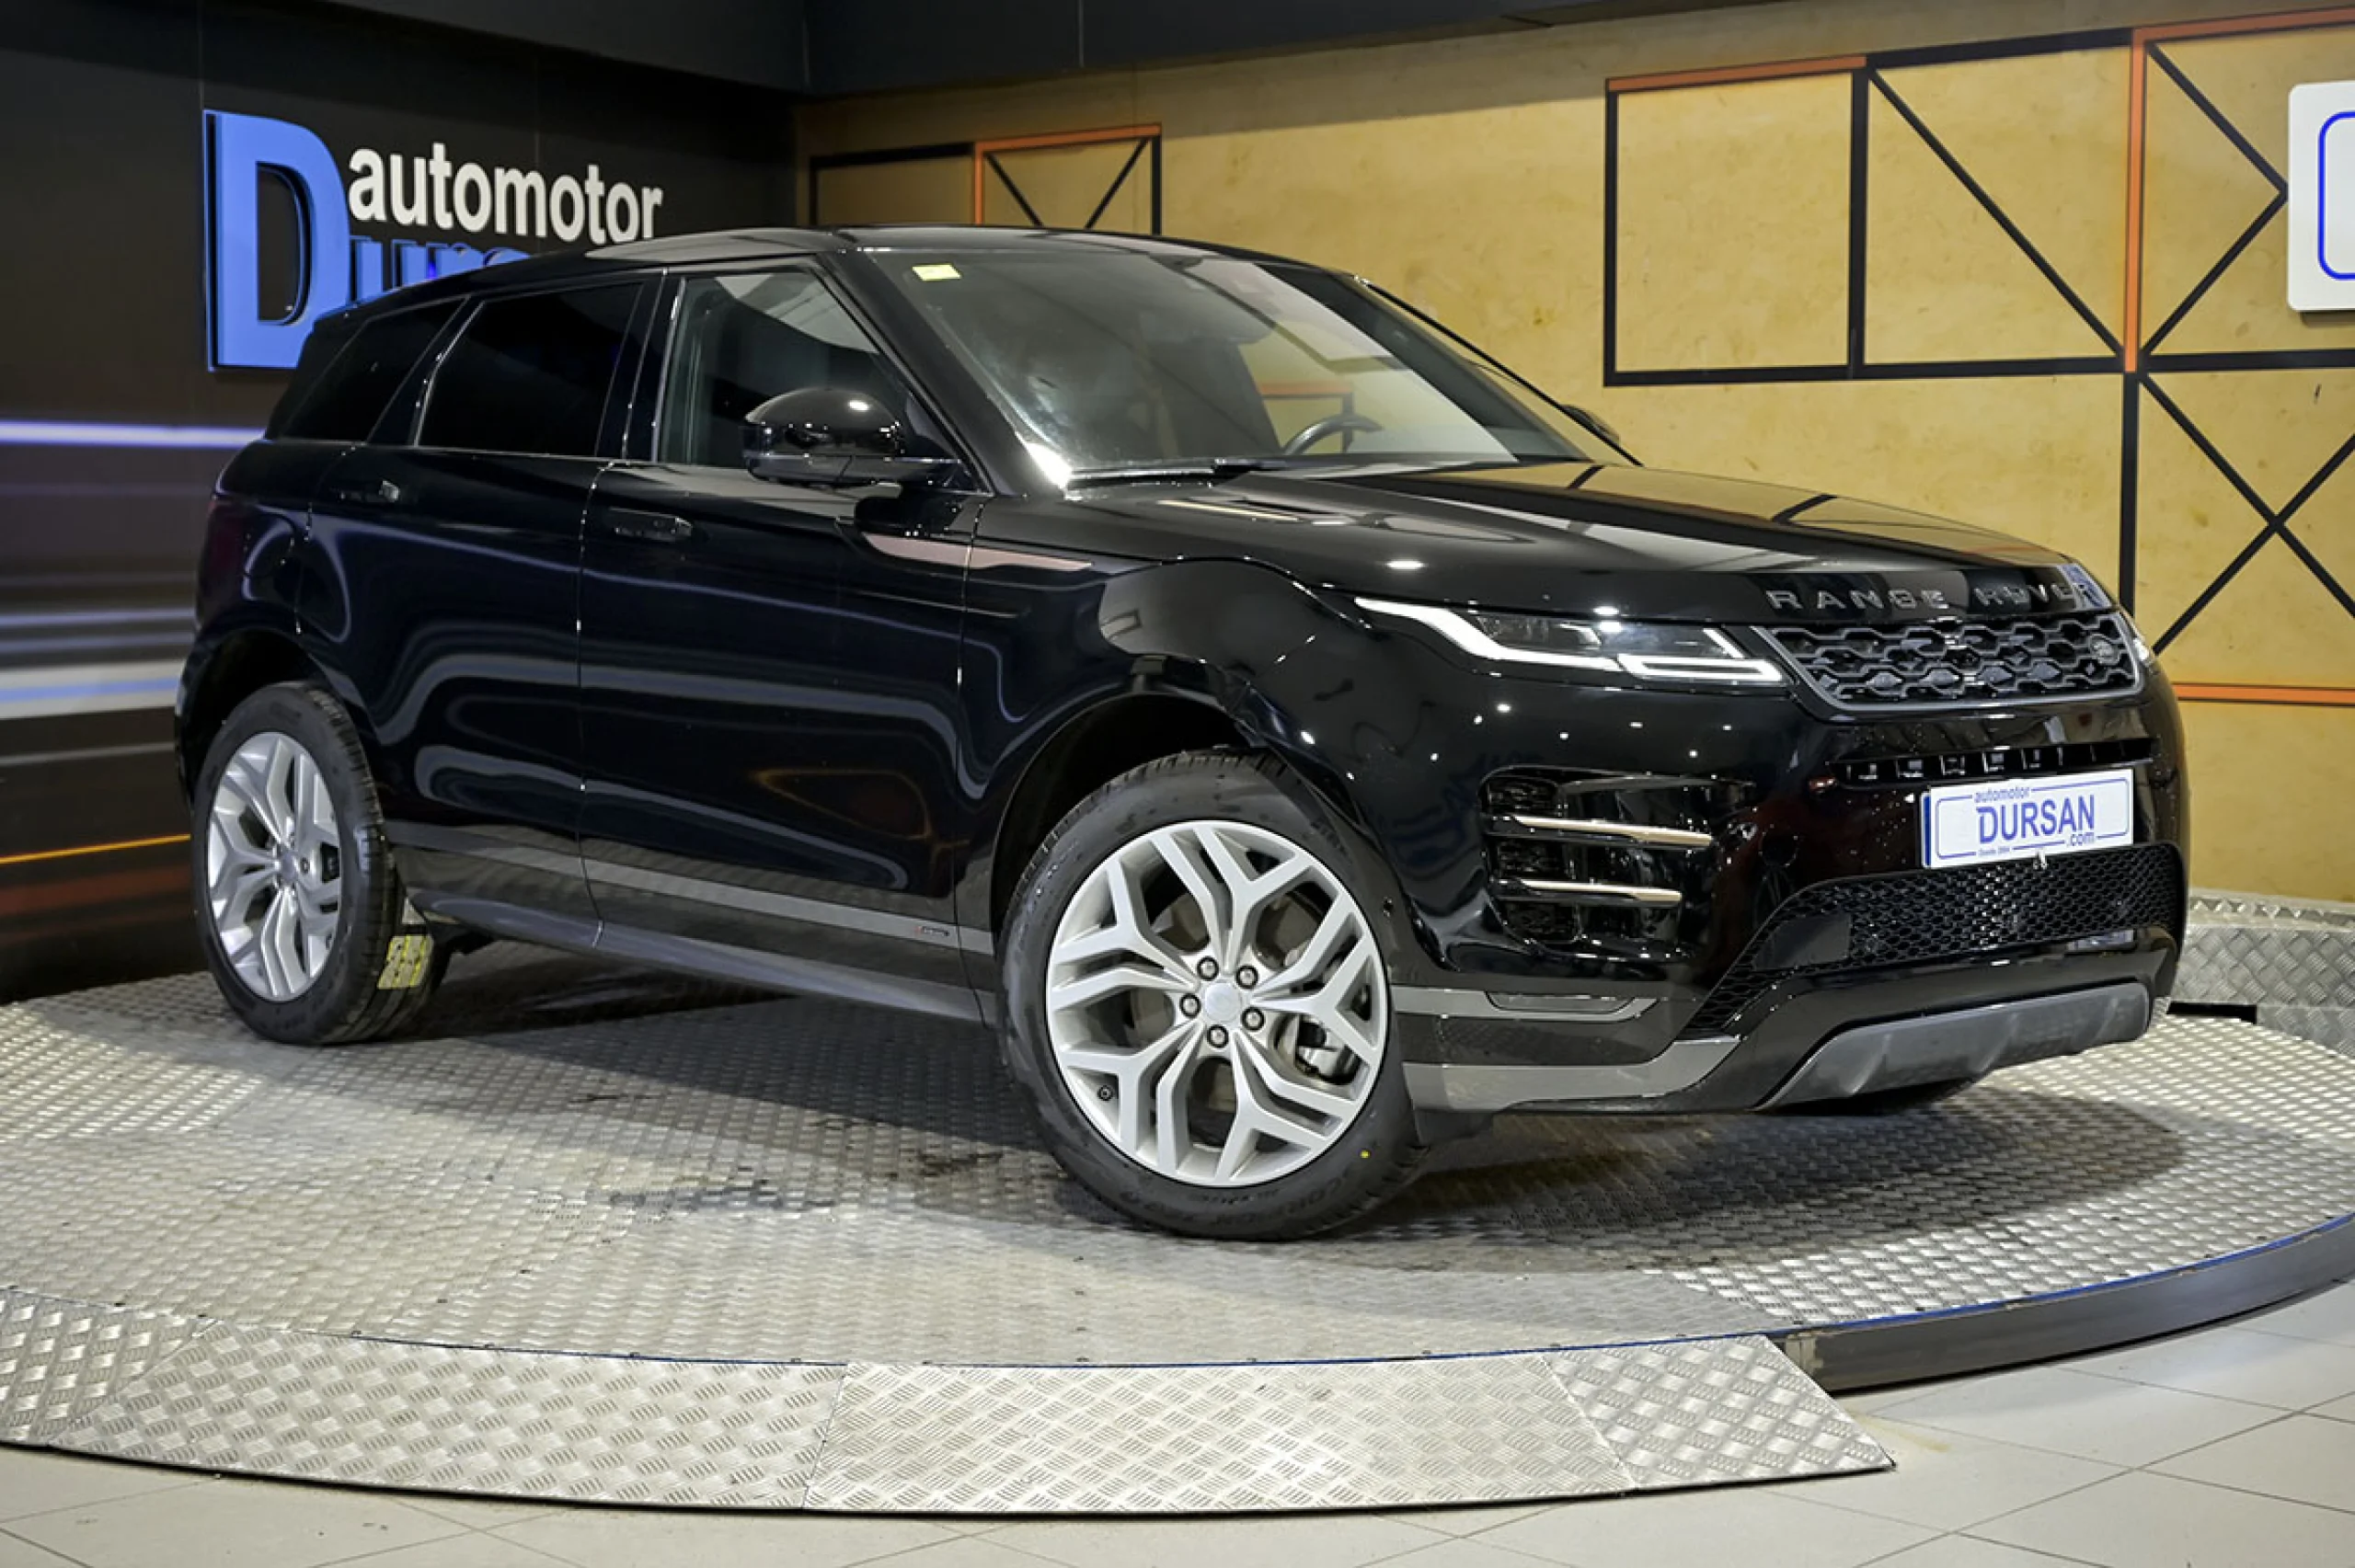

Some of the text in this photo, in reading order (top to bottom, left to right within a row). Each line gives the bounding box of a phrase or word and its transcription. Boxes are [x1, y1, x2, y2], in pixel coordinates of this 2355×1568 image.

[349, 142, 663, 246] automotor
[1765, 589, 1950, 610] RANGE
[1976, 794, 2095, 844] DURSAN
